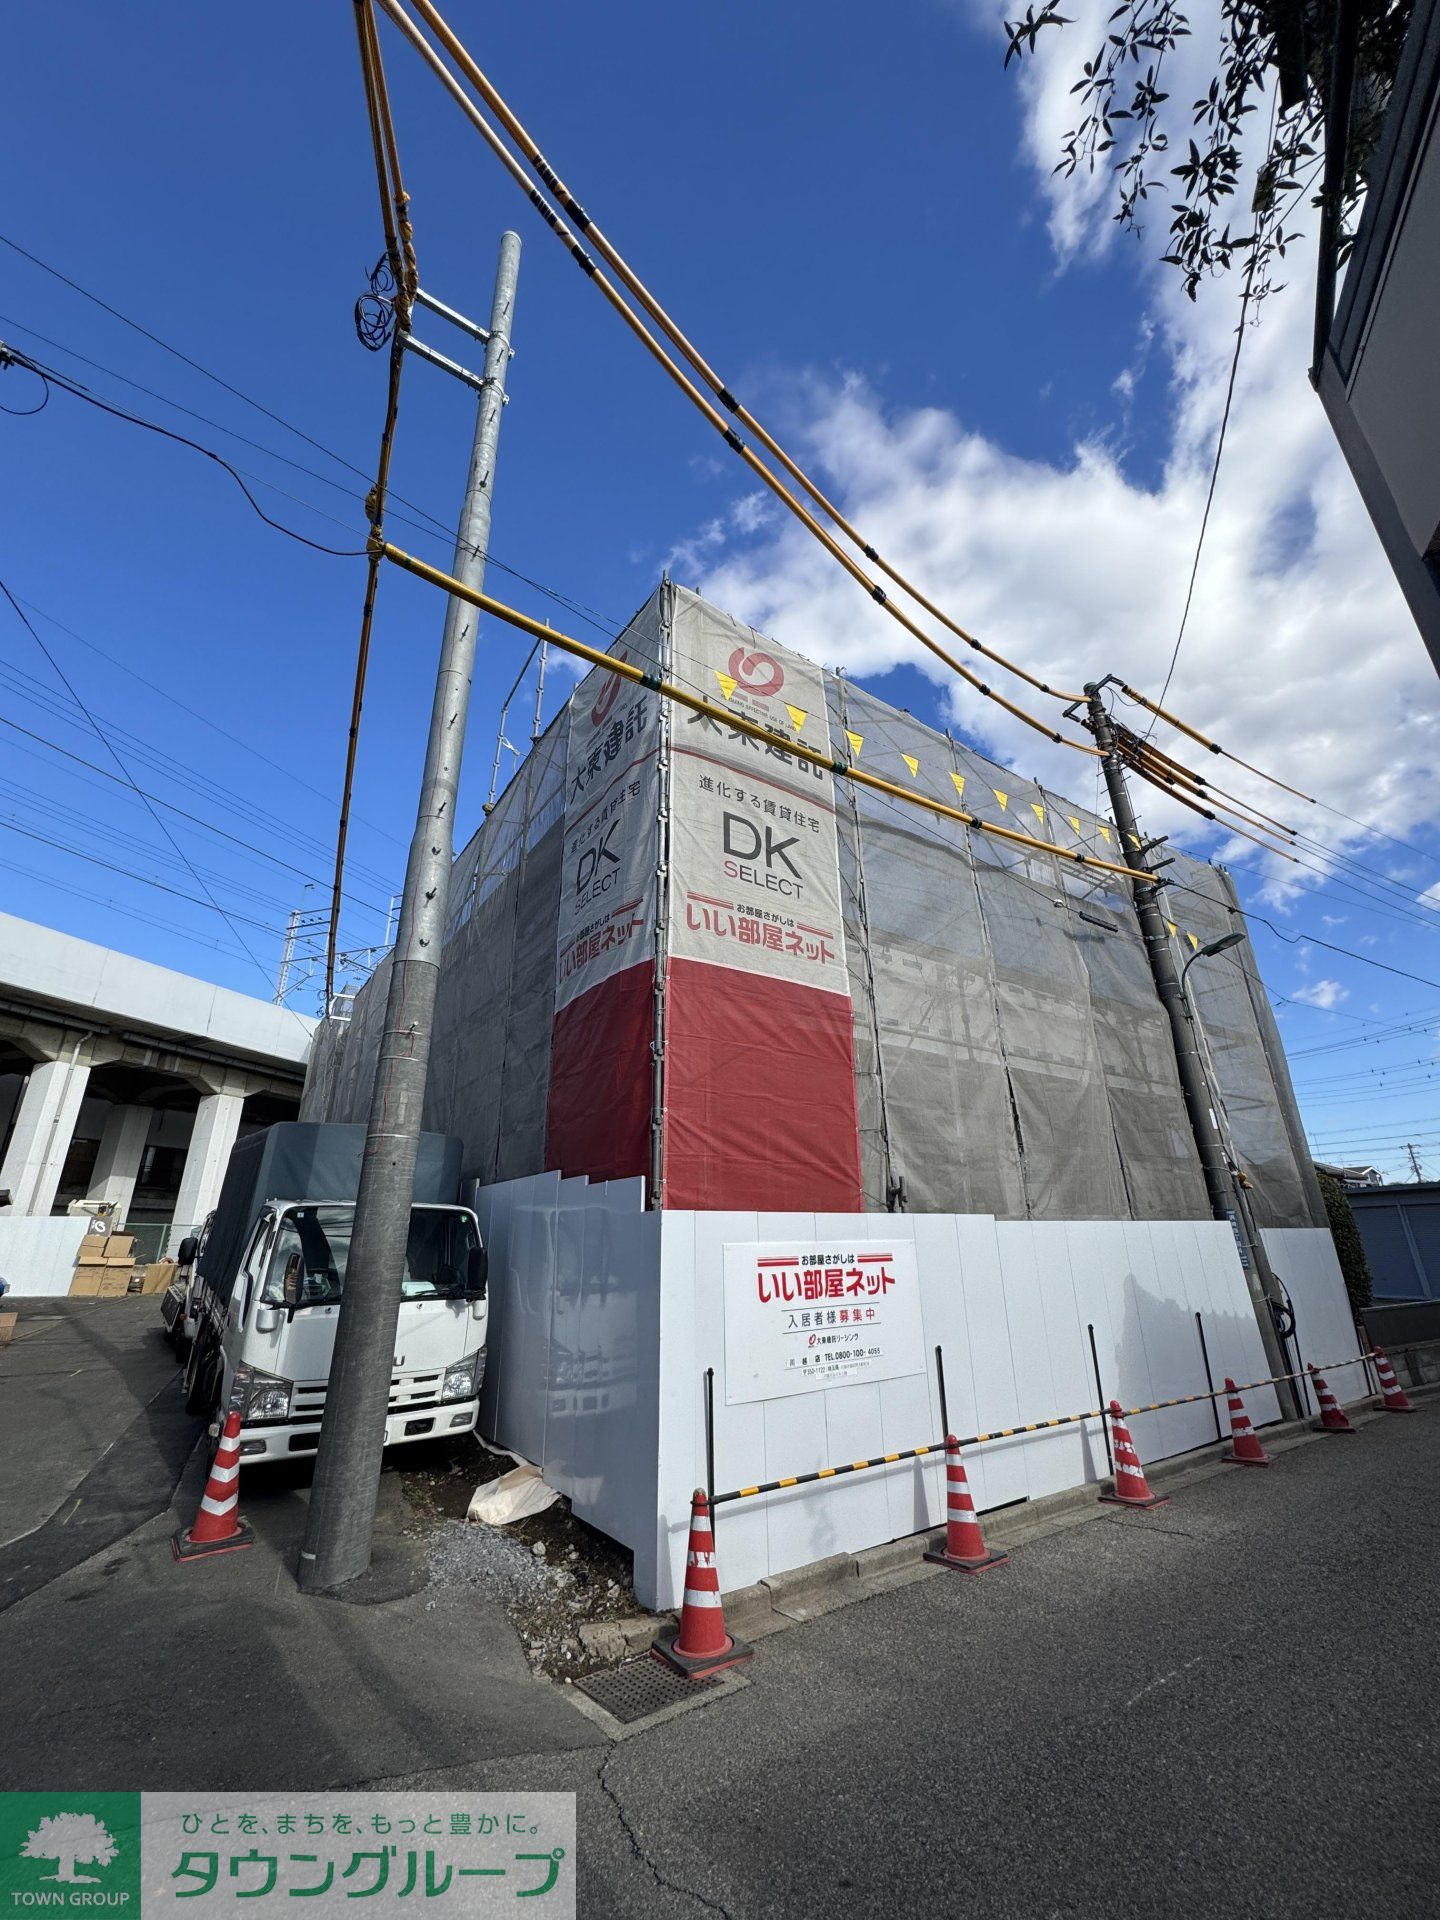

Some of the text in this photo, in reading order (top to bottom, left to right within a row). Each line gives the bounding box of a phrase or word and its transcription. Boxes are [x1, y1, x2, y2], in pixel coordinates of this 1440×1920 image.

[570, 694, 647, 805] 大東建託
[699, 774, 820, 834] 進化する賃貸住宅
[576, 818, 621, 896] DK
[723, 811, 803, 880] DK
[574, 867, 621, 915] SELECT
[723, 860, 803, 899] SELECT
[686, 903, 835, 964] いい部屋ネット
[737, 903, 794, 928] お部屋さがしは
[559, 912, 644, 984] いい部屋ネット
[757, 1267, 896, 1303] いい部屋ネット
[801, 1254, 855, 1266] お部屋さがしは
[788, 1307, 875, 1329] 入居者様募集中
